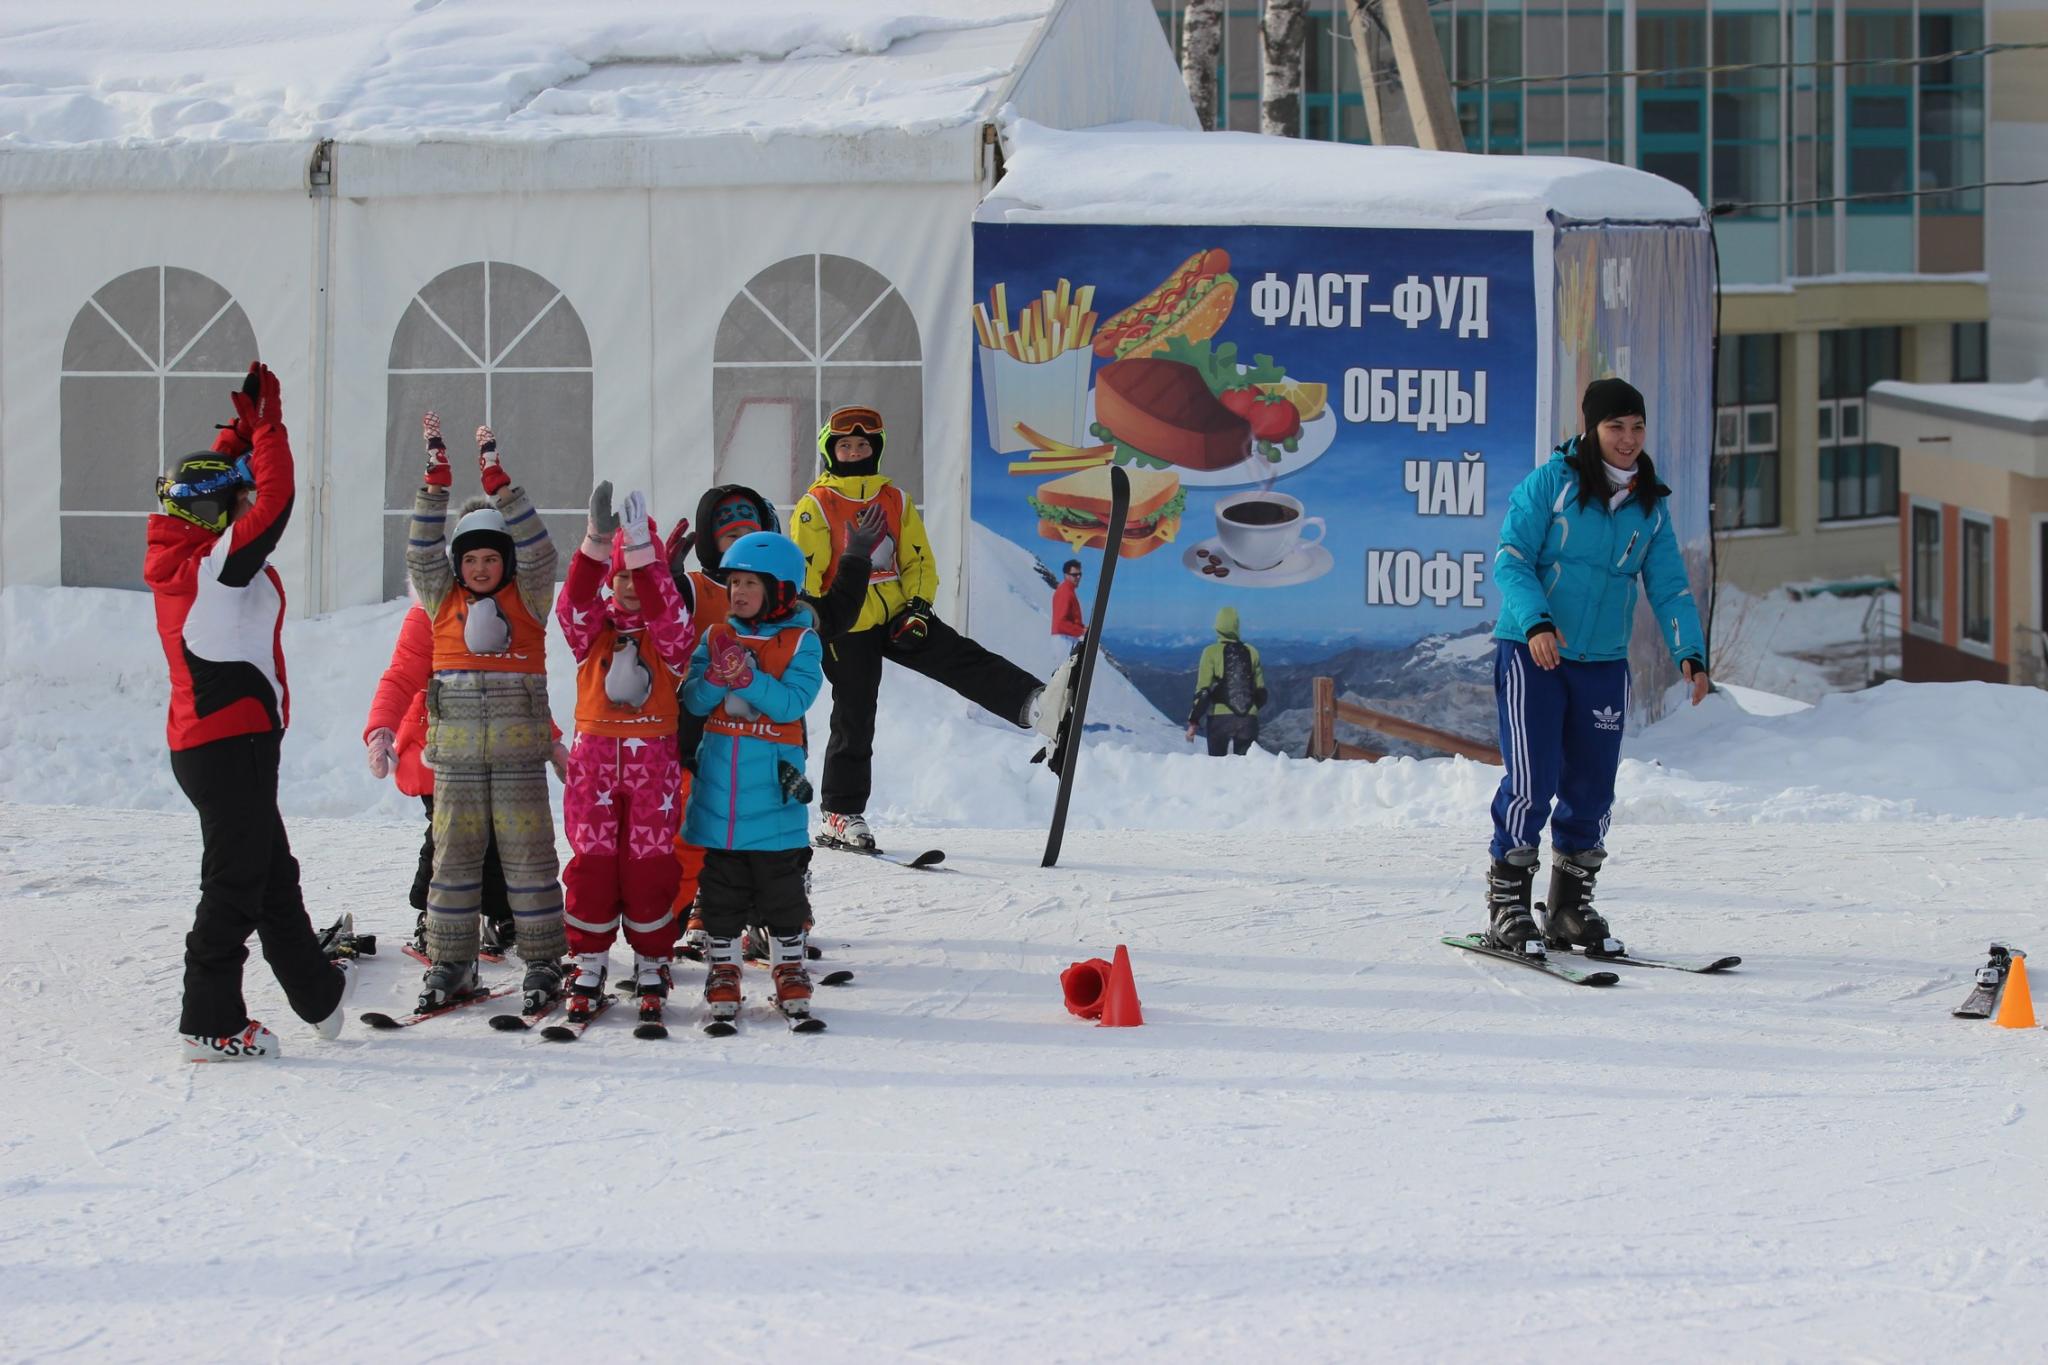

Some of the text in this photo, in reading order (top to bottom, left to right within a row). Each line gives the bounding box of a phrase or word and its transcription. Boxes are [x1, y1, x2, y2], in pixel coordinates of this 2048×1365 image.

[1250, 272, 1489, 338] ФАСТ-ФУД
[1343, 367, 1487, 432] ОБЕДЫ
[1404, 451, 1486, 516] ЧАЙ
[1367, 550, 1485, 608] КОФЕ
[1594, 721, 1620, 731] adidas
